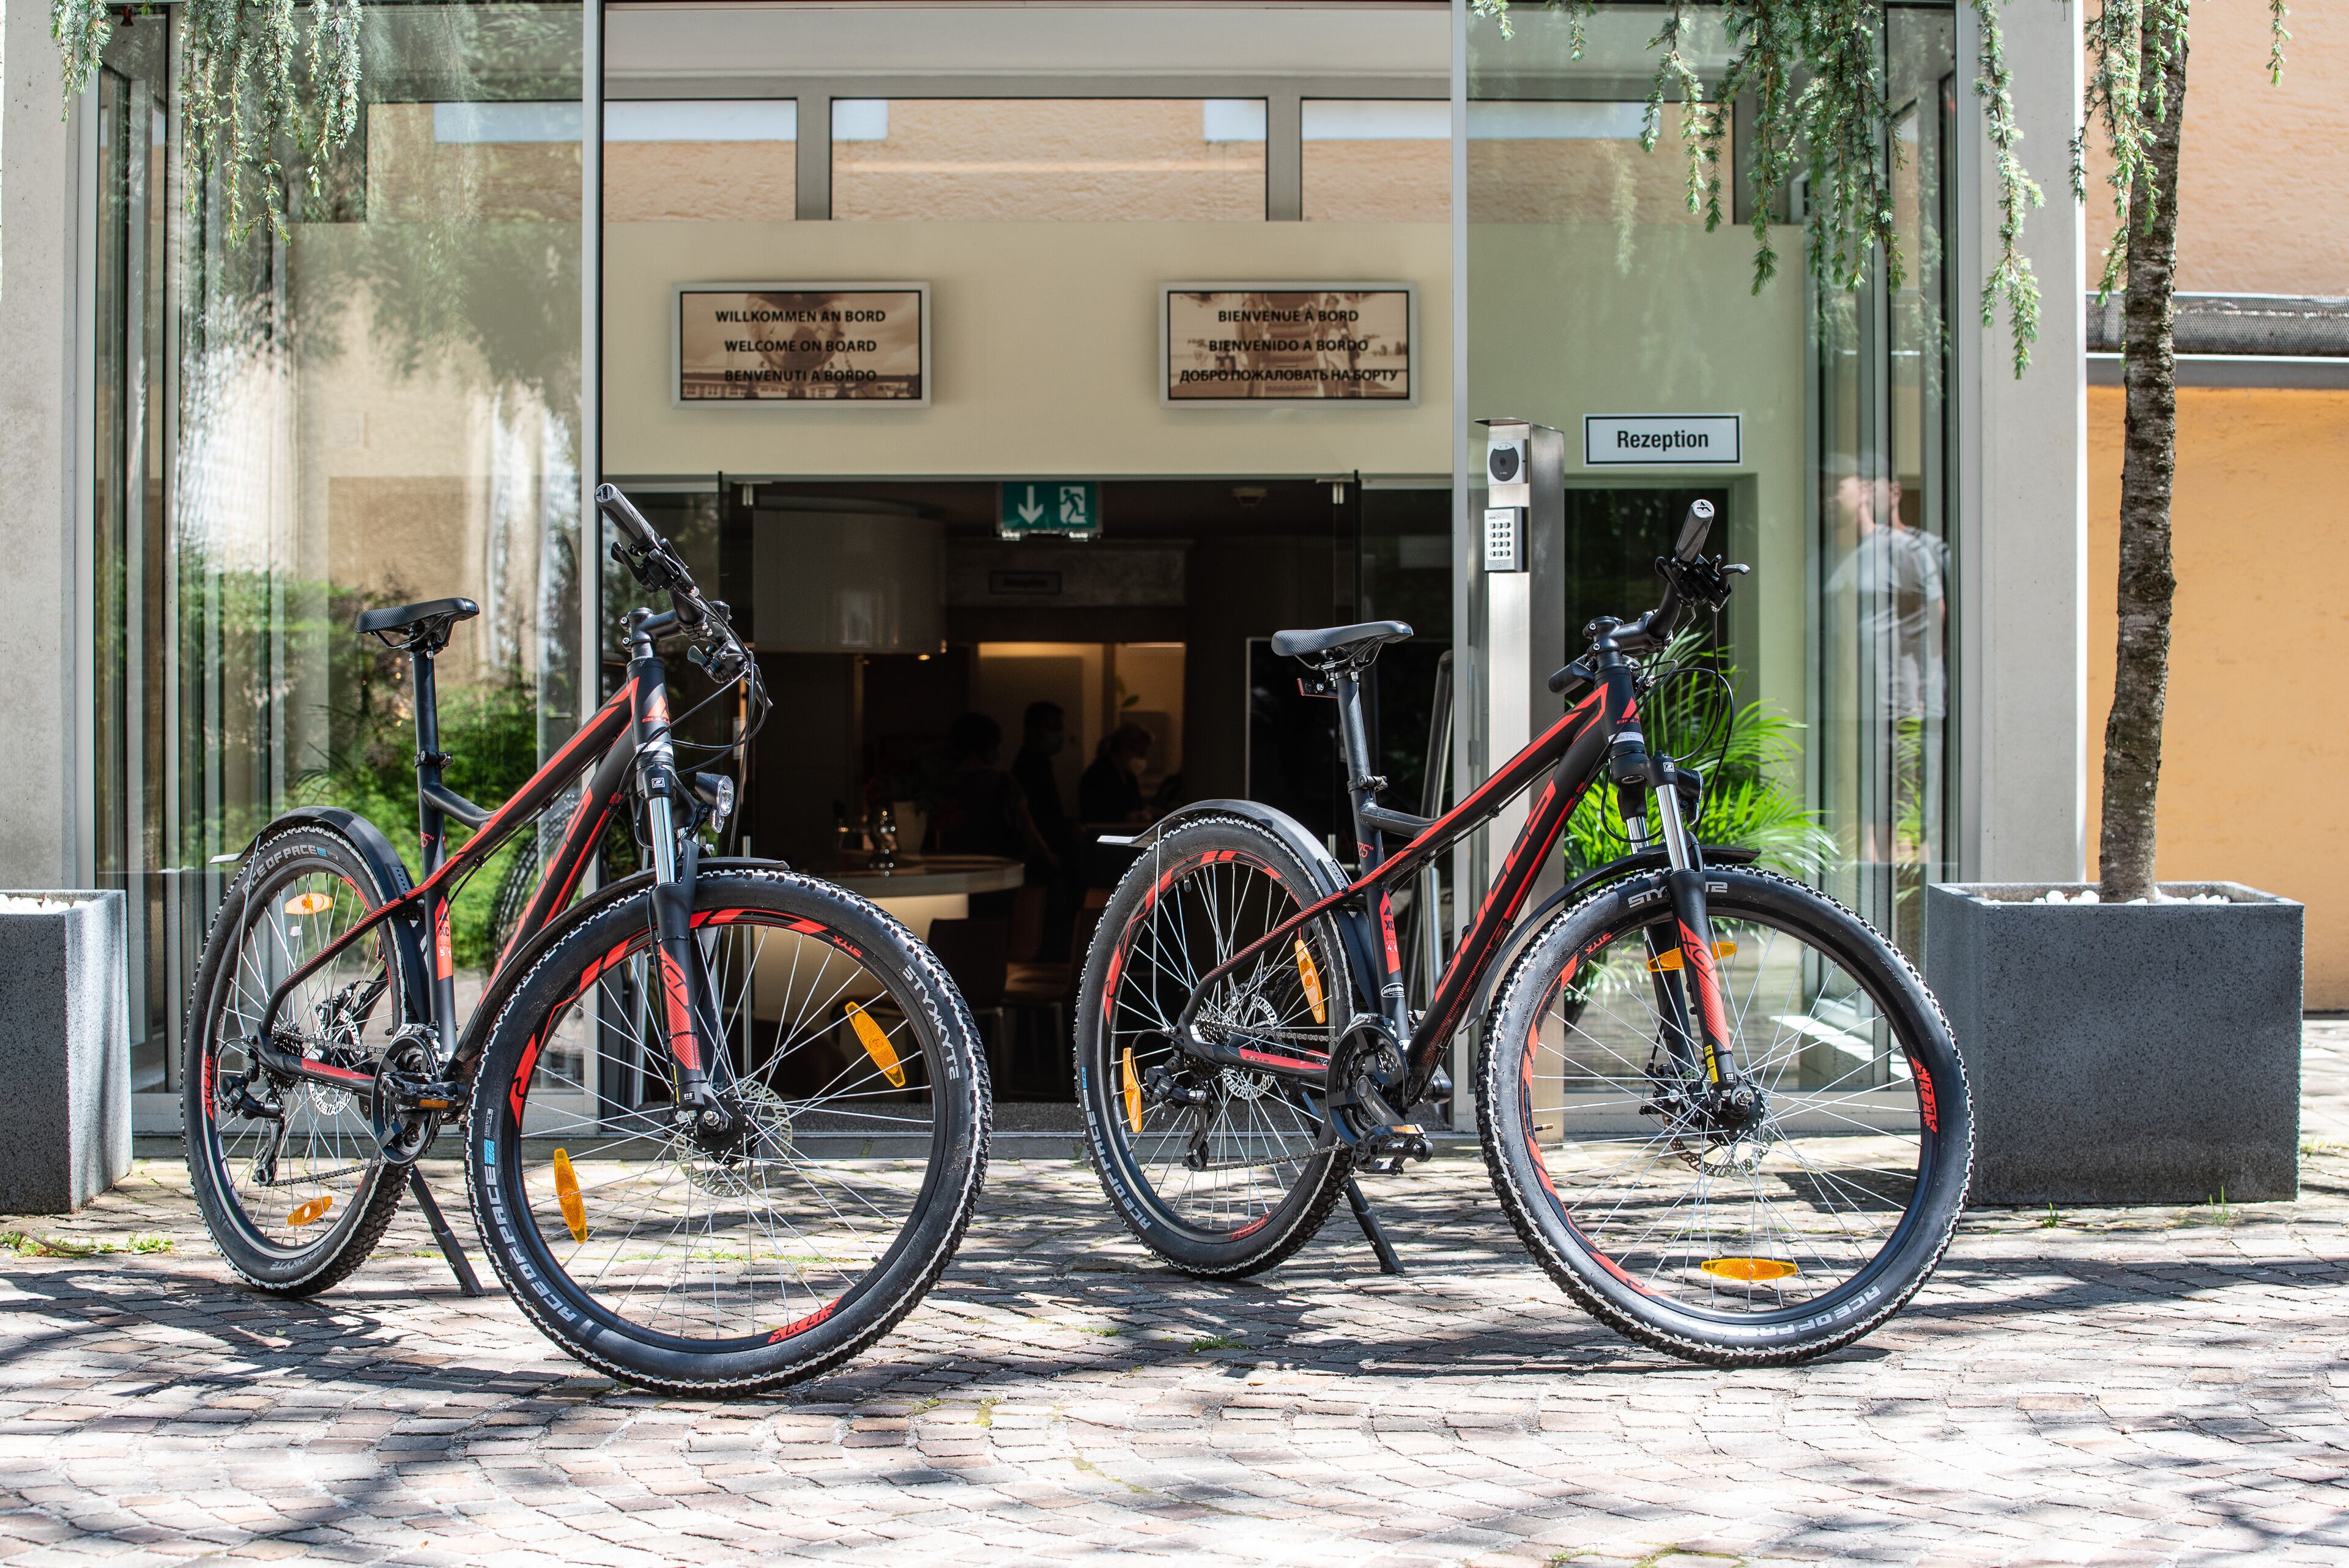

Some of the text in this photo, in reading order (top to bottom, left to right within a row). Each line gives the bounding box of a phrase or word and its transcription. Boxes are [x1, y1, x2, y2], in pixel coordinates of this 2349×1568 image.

[715, 310, 886, 322] WILLKOMMEN AN BORD
[1219, 310, 1300, 322] BIENVENUE
[1318, 310, 1359, 322] BORD
[724, 340, 877, 352] WELCOME ON BOARD
[1209, 340, 1368, 351] BIENVENIDO A BORDO
[724, 370, 877, 382] BENVENUTI A BORDO
[1179, 370, 1398, 383] ДОБРО ПОЖАЛОВАТЬ НА БОРТУ
[1617, 430, 1709, 451] Rezeption
[265, 851, 283, 869] OF
[283, 844, 317, 859] PACE
[1371, 1099, 1387, 1120] SHIMANO
[1084, 1110, 1151, 1231] ACE OF PACE
[483, 1165, 578, 1322] ACE OF PACE
[1833, 1285, 1881, 1319] ACE
[1797, 1313, 1832, 1332] OF
